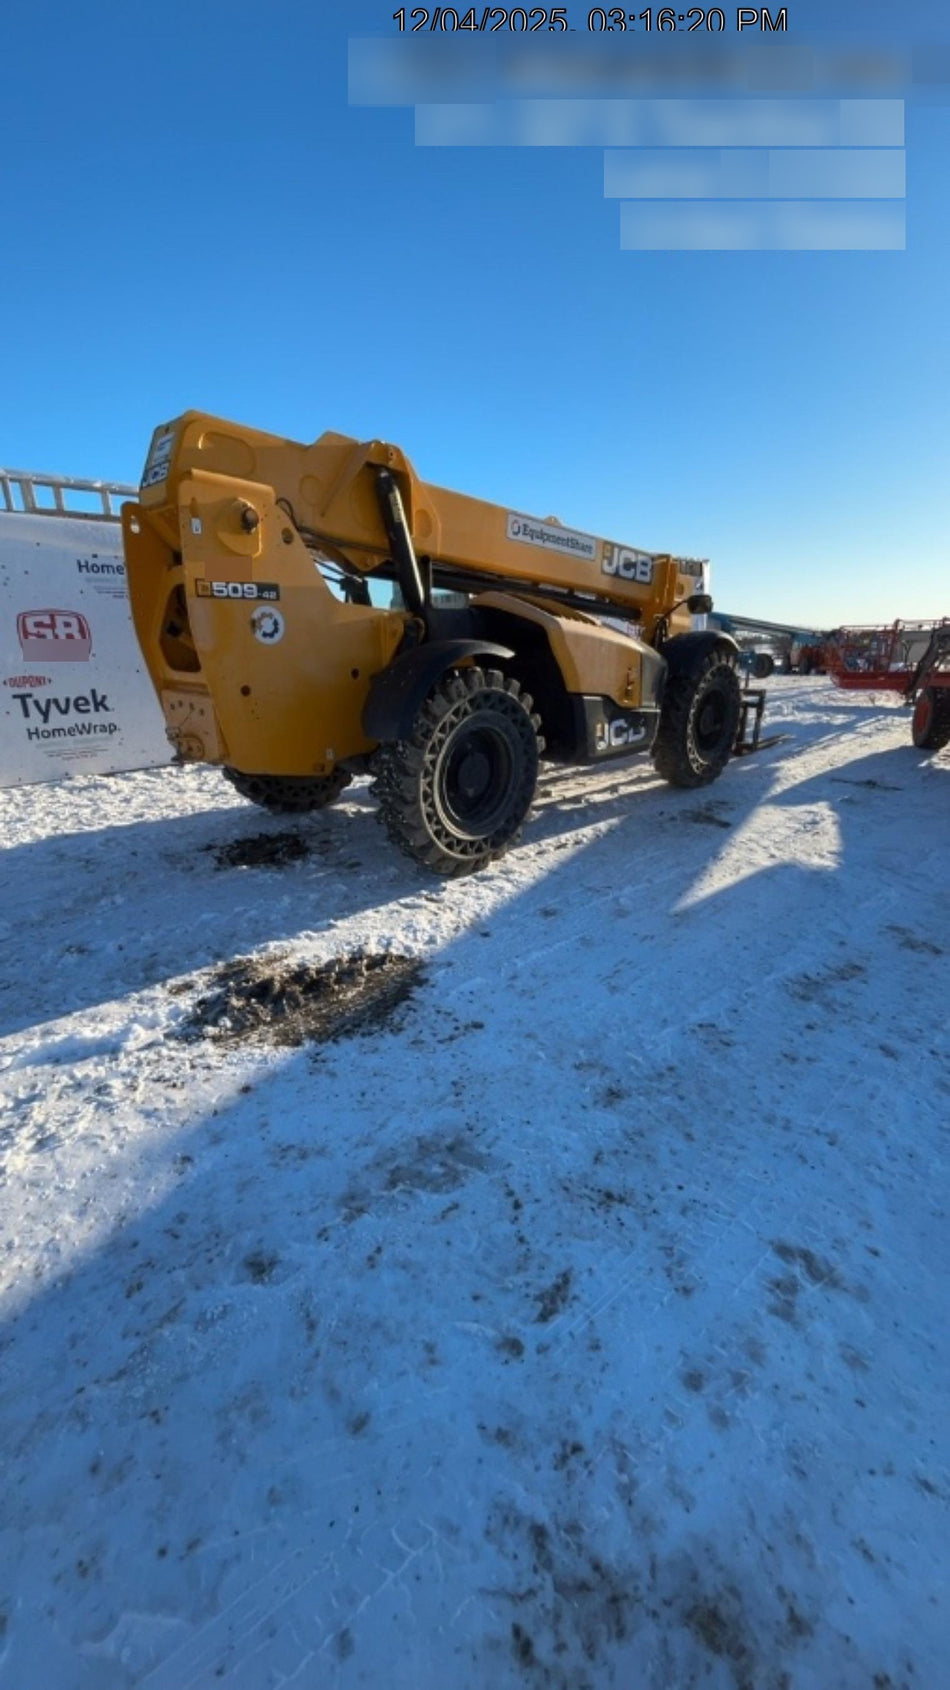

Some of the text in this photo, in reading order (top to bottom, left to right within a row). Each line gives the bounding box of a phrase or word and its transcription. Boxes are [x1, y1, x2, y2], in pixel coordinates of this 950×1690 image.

[143, 461, 169, 487] JCB
[77, 559, 125, 575] Home
[602, 546, 652, 583] JCB
[12, 688, 110, 724] Tyvek
[26, 722, 117, 741] HomeWrap
